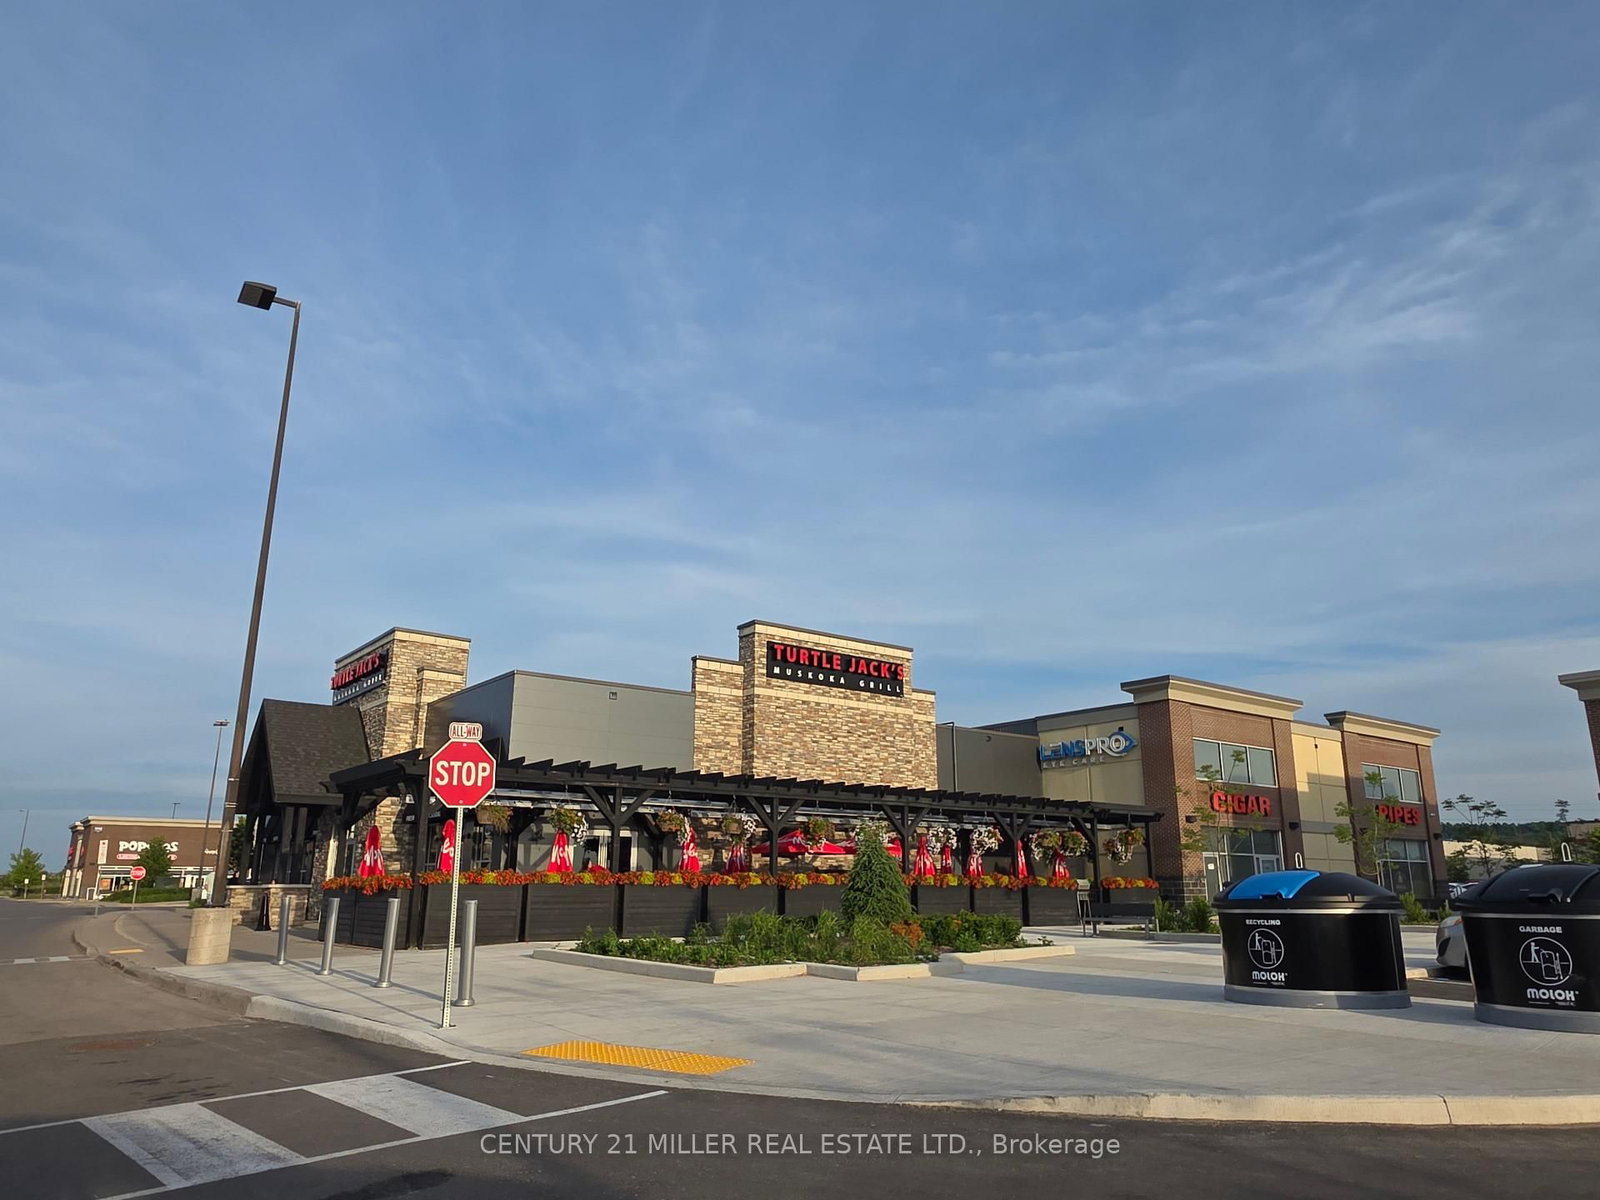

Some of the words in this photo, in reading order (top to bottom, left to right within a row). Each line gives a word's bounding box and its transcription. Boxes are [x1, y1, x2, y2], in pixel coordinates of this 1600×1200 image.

[773, 644, 842, 670] TURTLE
[848, 658, 905, 680] JACK'S
[773, 666, 845, 684] MUSKOKA
[859, 680, 900, 693] GRILL
[452, 725, 480, 737] ALL-WAY
[1073, 756, 1105, 765] CARE
[435, 760, 491, 787] STOP
[1212, 790, 1272, 816] CIGAR
[1378, 803, 1422, 825] PIPES
[1519, 925, 1563, 933] GARBAGE
